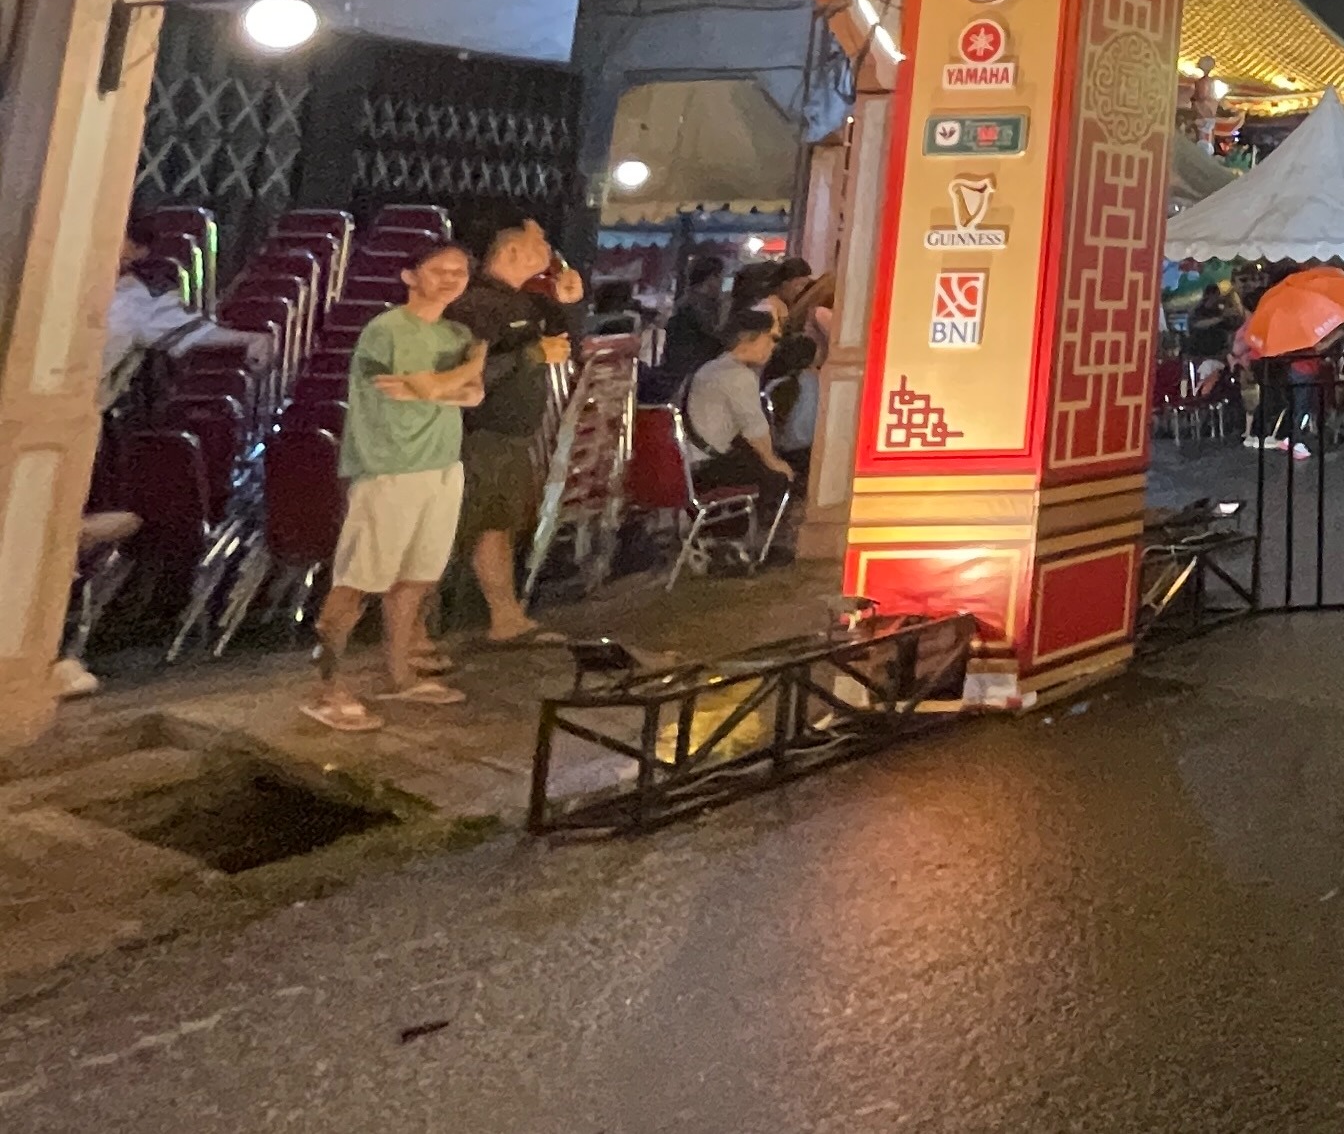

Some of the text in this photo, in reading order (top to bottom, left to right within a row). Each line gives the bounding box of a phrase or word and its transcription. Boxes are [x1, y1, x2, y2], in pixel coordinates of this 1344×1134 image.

[946, 67, 1010, 86] YAMAHA
[926, 231, 1003, 247] GUINNESS
[931, 321, 978, 345] BNI
